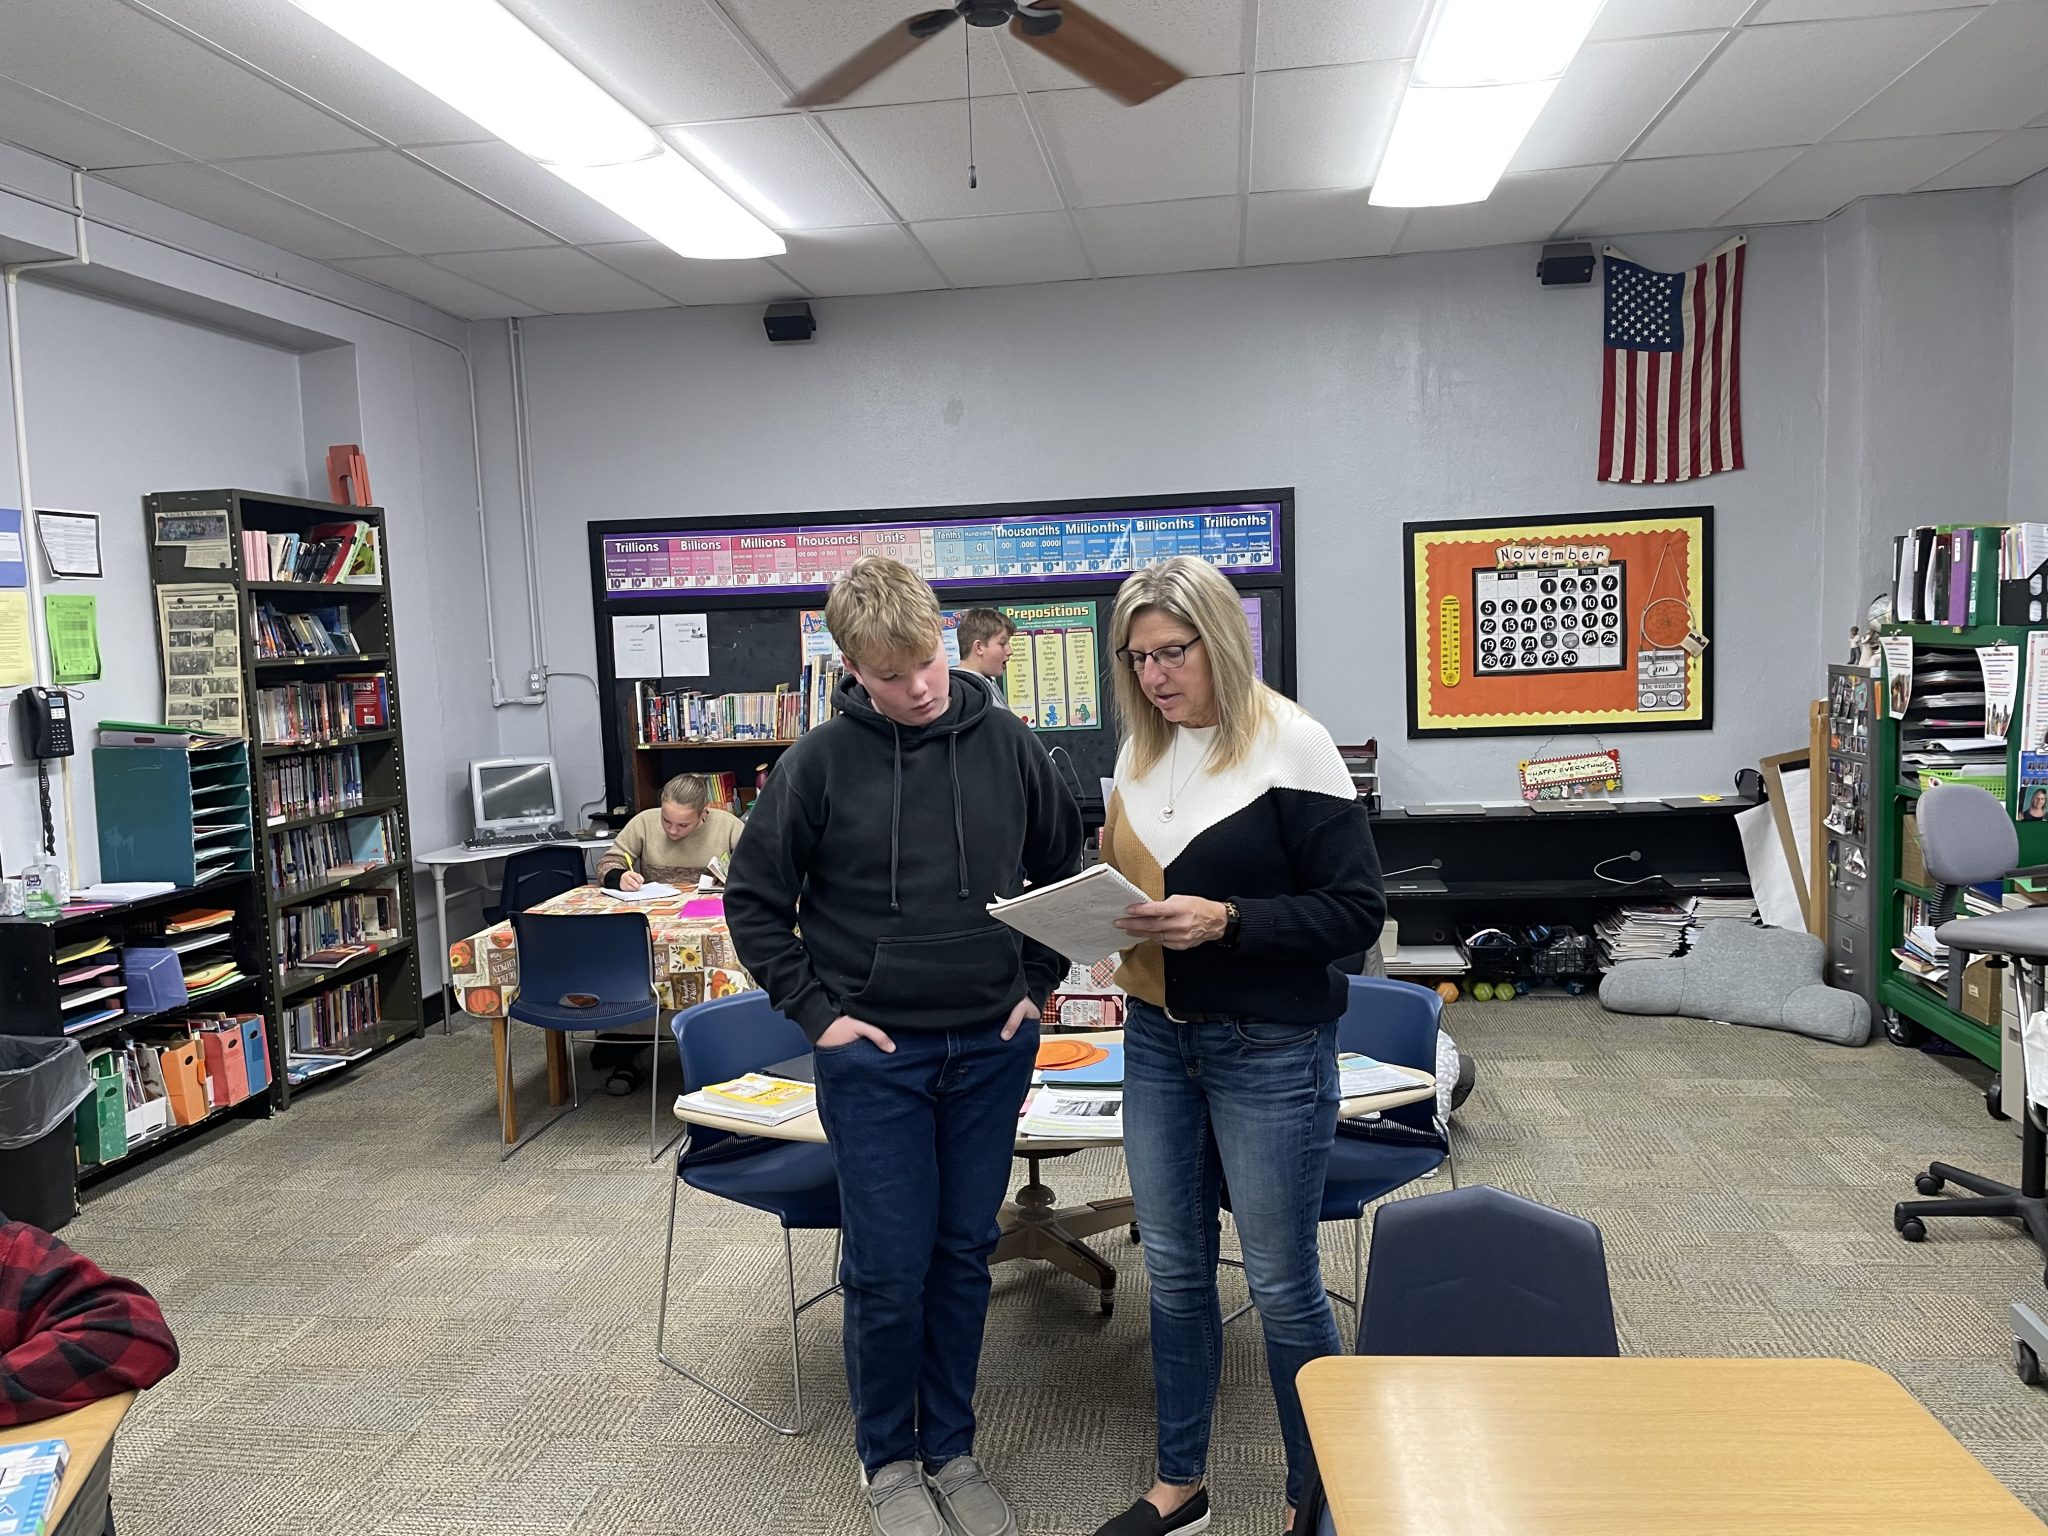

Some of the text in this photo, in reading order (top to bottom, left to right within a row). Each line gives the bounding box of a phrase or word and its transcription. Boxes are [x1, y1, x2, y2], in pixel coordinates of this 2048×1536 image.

[615, 543, 659, 553] Trillions
[681, 540, 721, 551] Billions
[741, 538, 786, 548] Millions
[797, 535, 859, 546] Thousands
[876, 532, 906, 543] Units
[937, 531, 960, 540] Tenths
[996, 525, 1060, 537] Thousandths
[1066, 522, 1126, 534] Millionths
[1136, 519, 1195, 531] Billionths
[1204, 515, 1266, 528] Trillionths
[865, 547, 879, 556] 100
[887, 547, 896, 555] 10
[974, 543, 985, 551] .01
[1500, 547, 1604, 561] November
[1546, 578, 1613, 591] 1 2 3 4
[1484, 596, 1615, 613] 5 6 7 8 9 10 11
[1006, 605, 1089, 621] Prepositions
[1483, 615, 1615, 632] 12 13 14 15 16 17 18
[1584, 632, 1596, 643] 24
[1603, 634, 1616, 643] 25
[1484, 639, 1535, 650] 19 20 21
[1483, 652, 1576, 666] 26 27 28 29 30
[1560, 761, 1608, 773] EVERYTHING
[492, 959, 516, 974] UMPKIN
